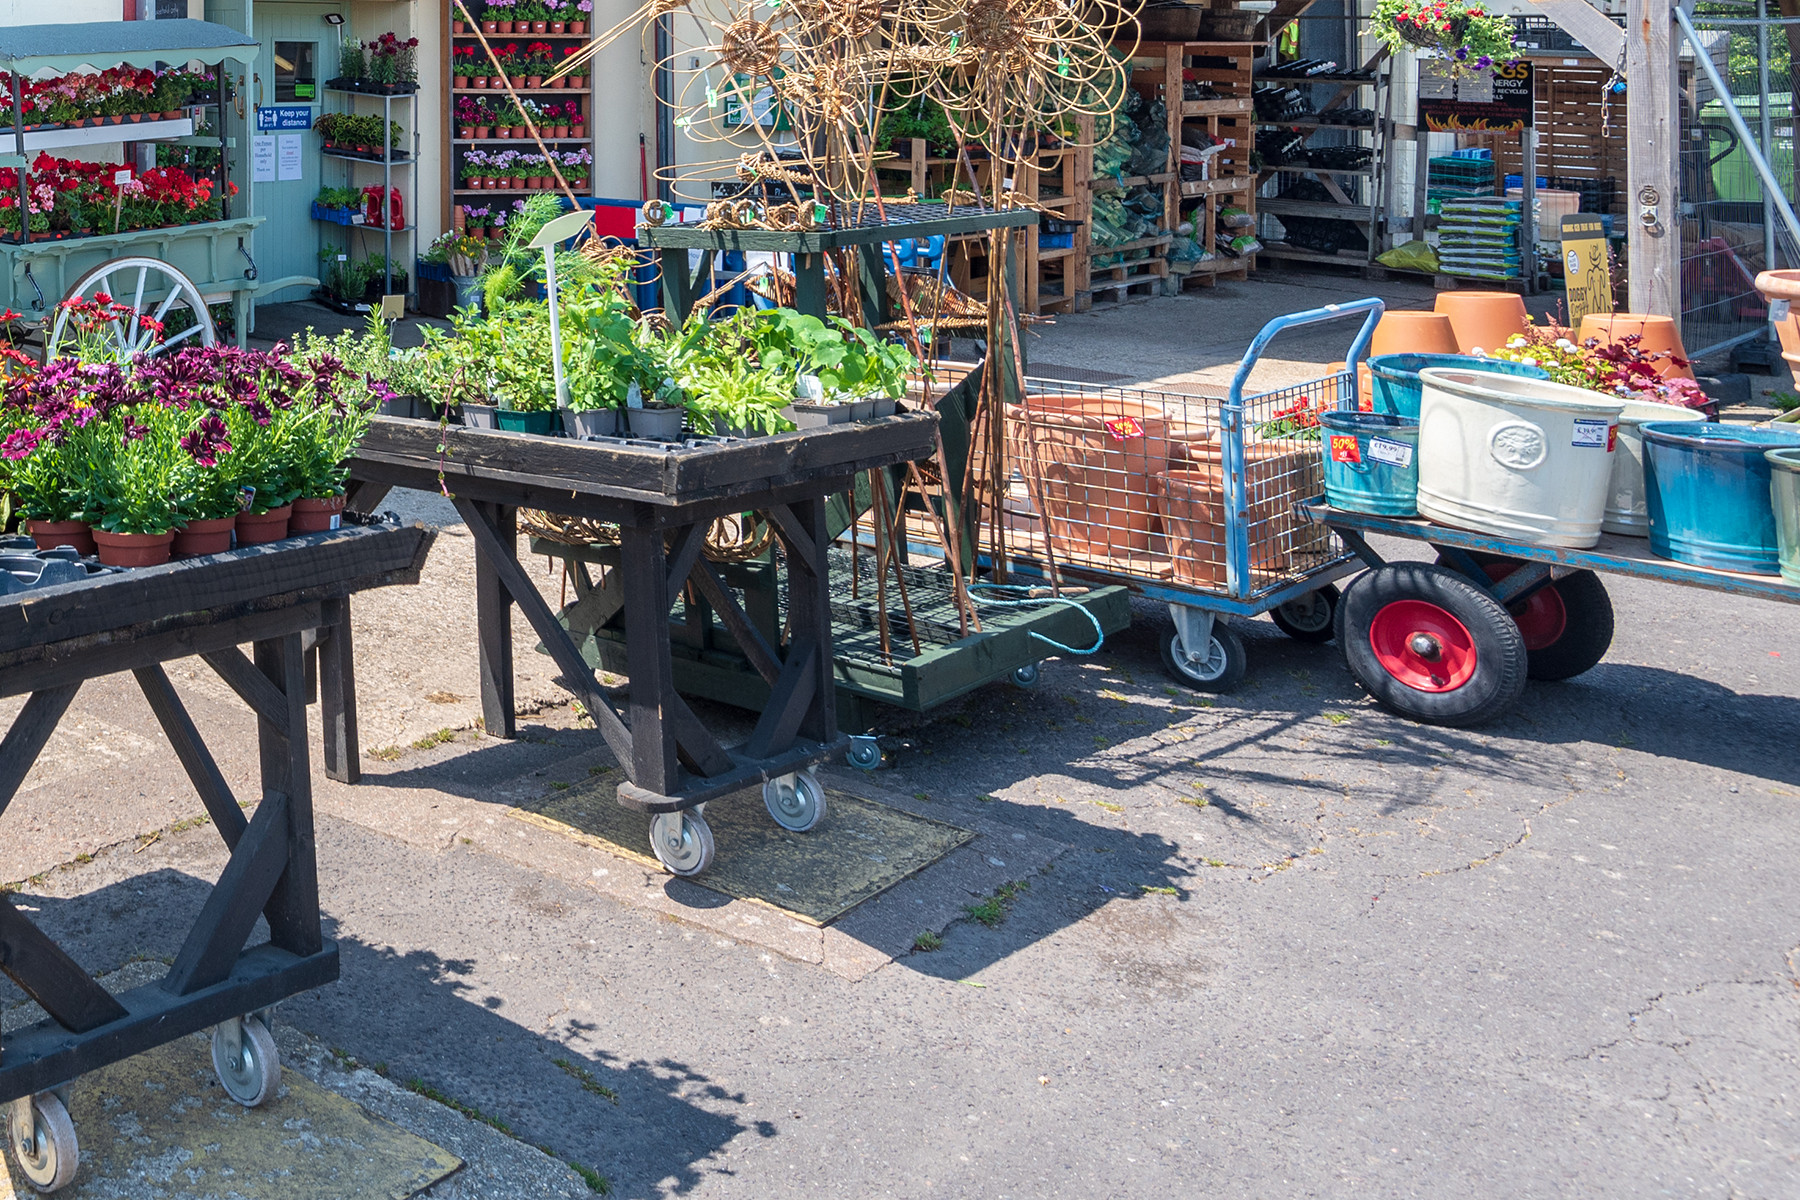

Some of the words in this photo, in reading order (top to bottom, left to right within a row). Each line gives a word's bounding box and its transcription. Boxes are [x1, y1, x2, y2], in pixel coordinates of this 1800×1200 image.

[1493, 79, 1524, 87] NERGY
[280, 110, 295, 118] Keep
[296, 110, 309, 118] your
[1332, 438, 1355, 450] 50%
[1374, 442, 1397, 451] £19.99
